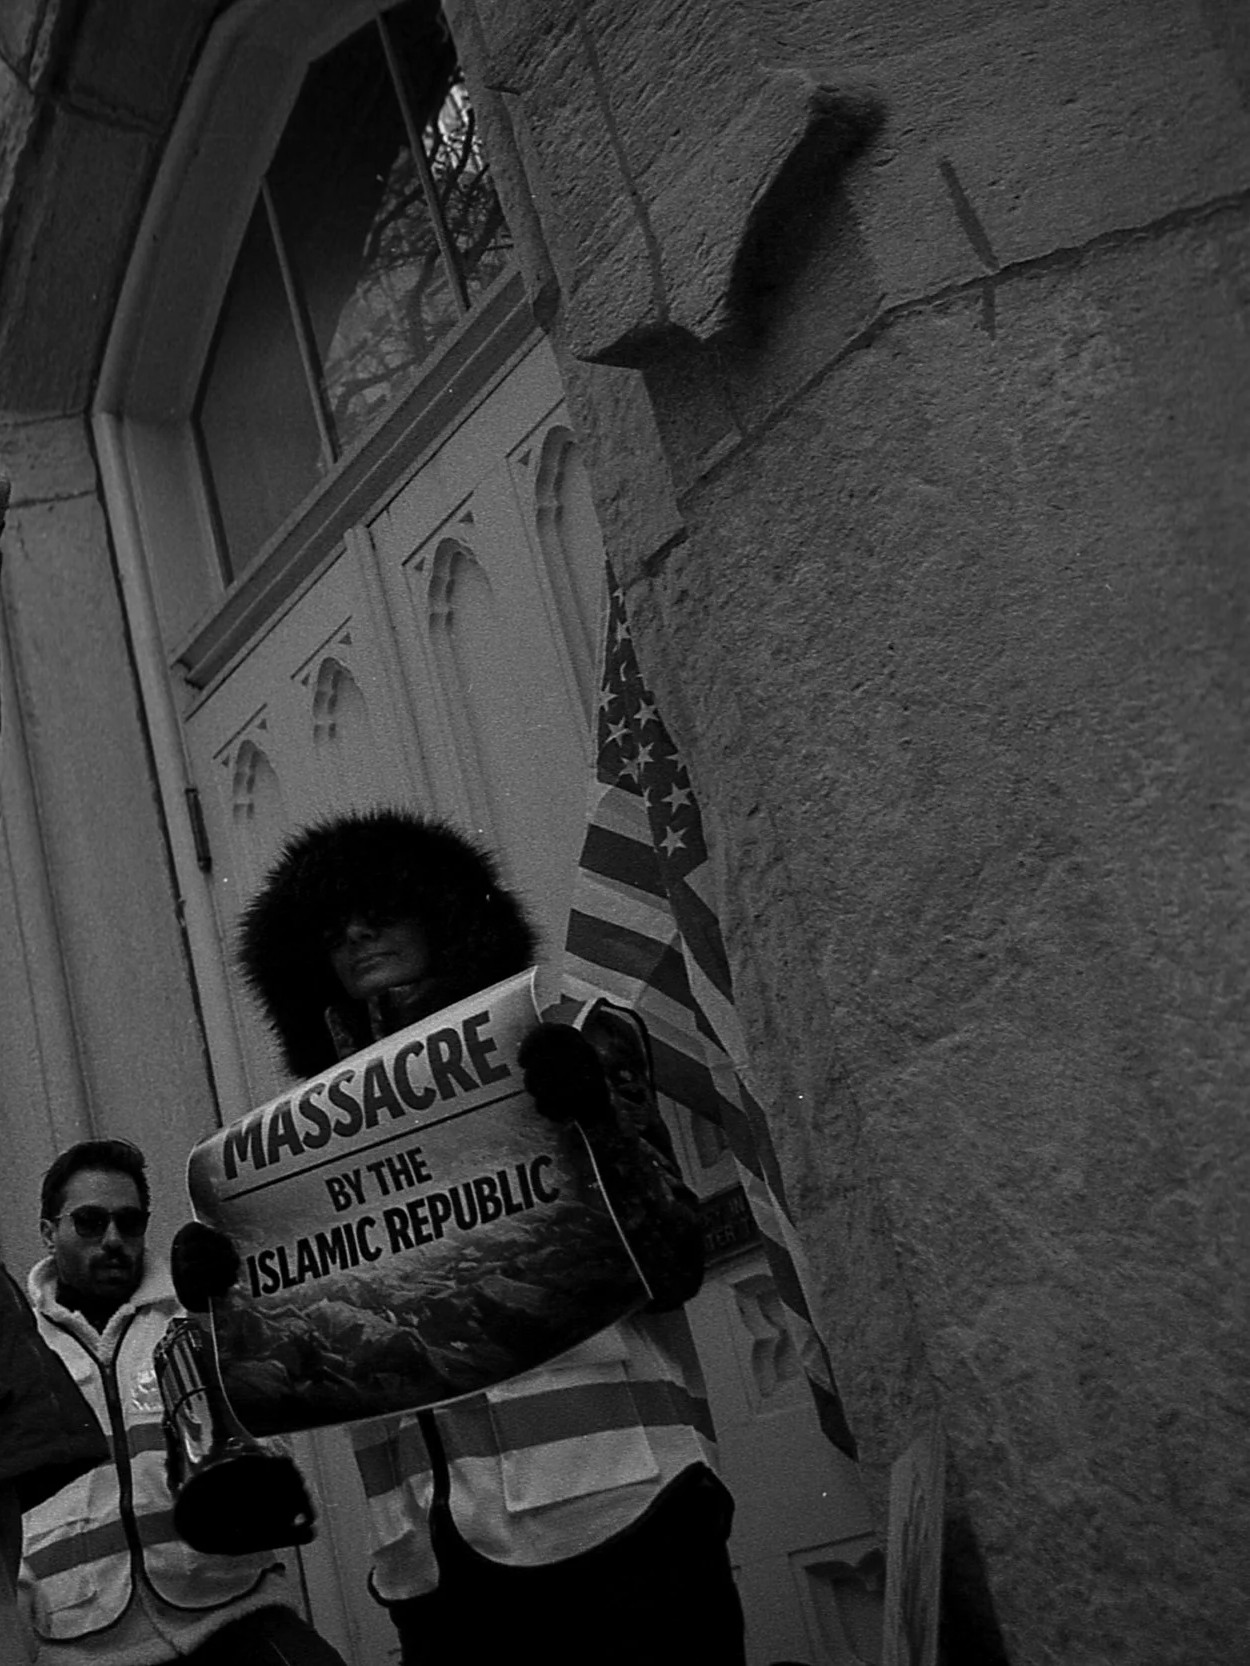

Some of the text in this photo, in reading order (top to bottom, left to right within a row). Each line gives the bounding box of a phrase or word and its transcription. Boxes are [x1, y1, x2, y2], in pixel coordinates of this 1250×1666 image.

[223, 1010, 512, 1180] MASSACRE
[247, 1154, 560, 1298] ISLAMIC REPUBLIC
[325, 1147, 433, 1212] BY THE
